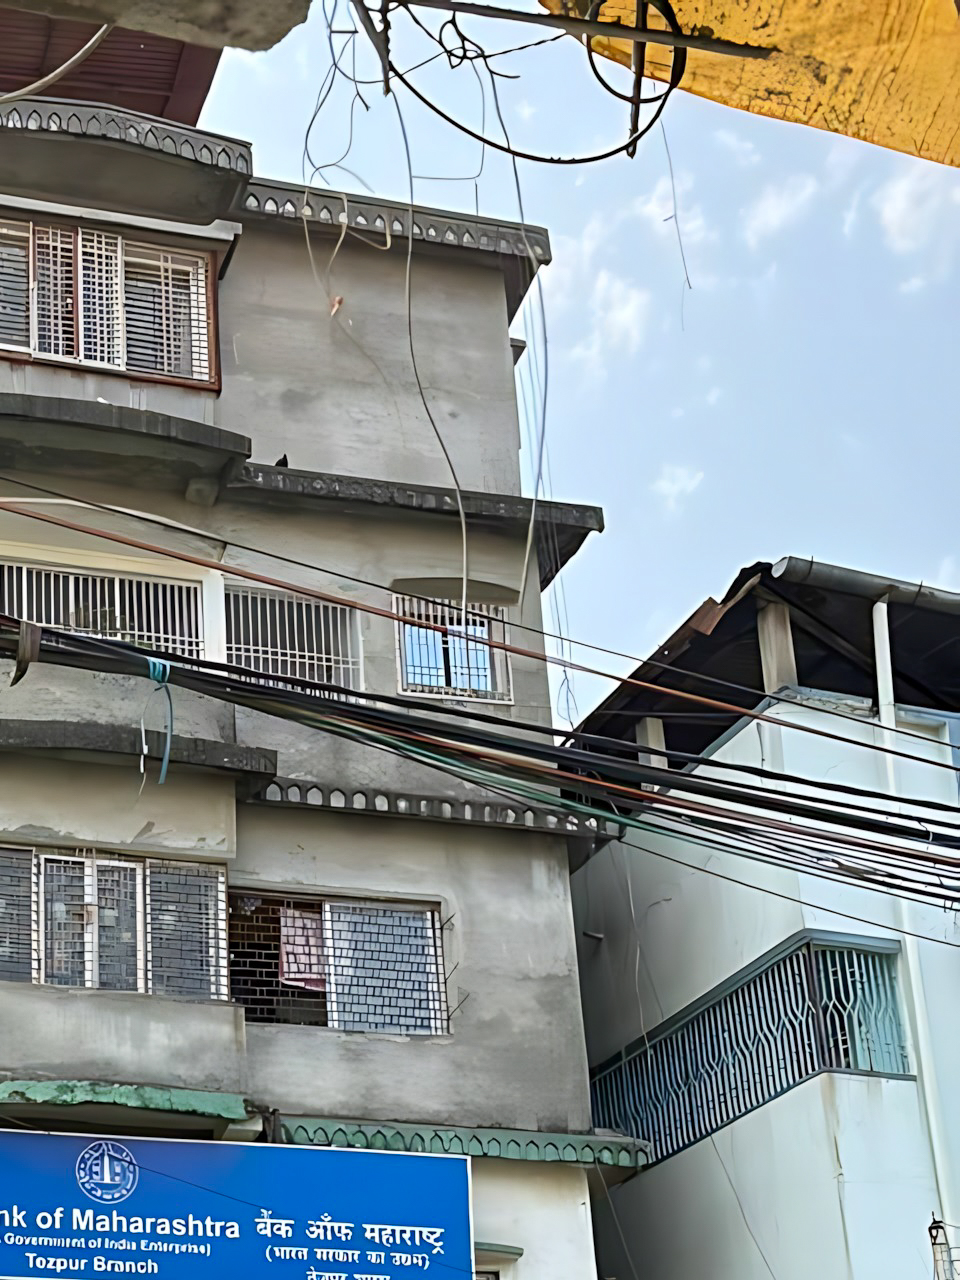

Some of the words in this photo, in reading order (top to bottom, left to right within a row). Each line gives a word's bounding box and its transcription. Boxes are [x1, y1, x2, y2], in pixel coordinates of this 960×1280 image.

[35, 1207, 65, 1230] of
[72, 1208, 240, 1239] Maharashtra
[87, 1238, 102, 1249] of
[362, 1223, 445, 1255] महाराष्ट्र
[93, 1256, 159, 1274] Branch
